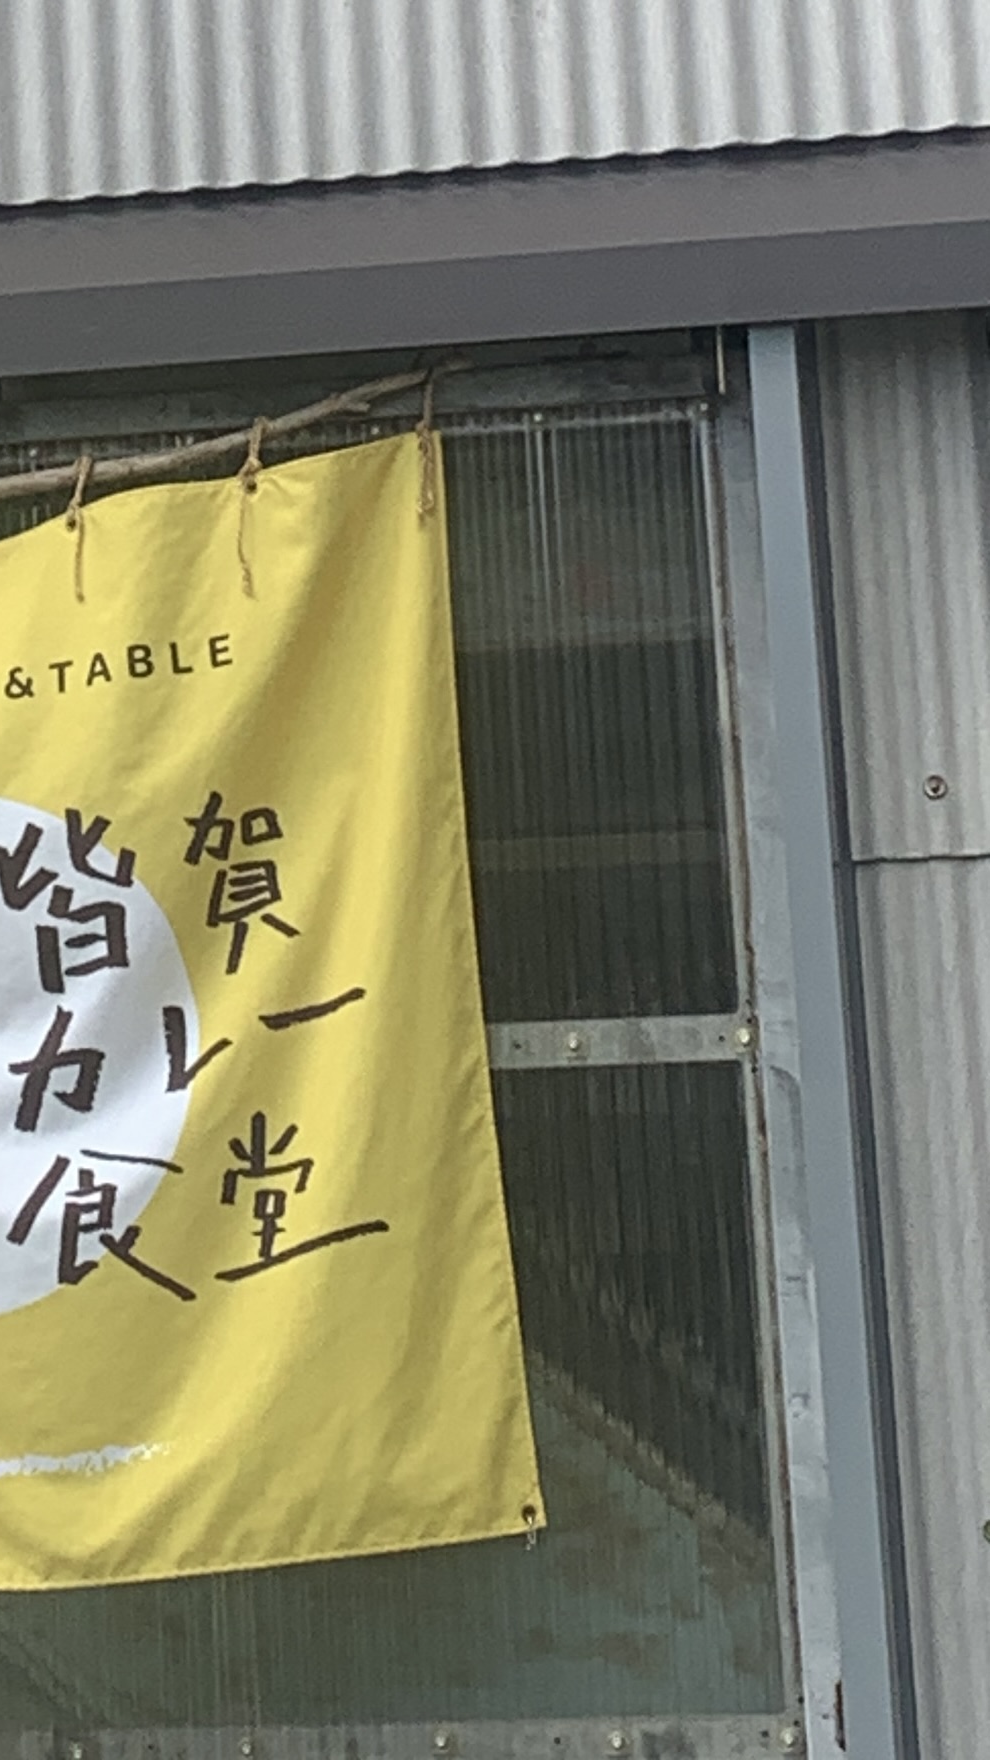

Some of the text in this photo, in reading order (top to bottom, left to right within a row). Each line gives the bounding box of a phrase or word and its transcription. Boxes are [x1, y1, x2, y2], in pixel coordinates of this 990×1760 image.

[10, 987, 365, 1132] カレー
[9, 1111, 390, 1300] 食堂
